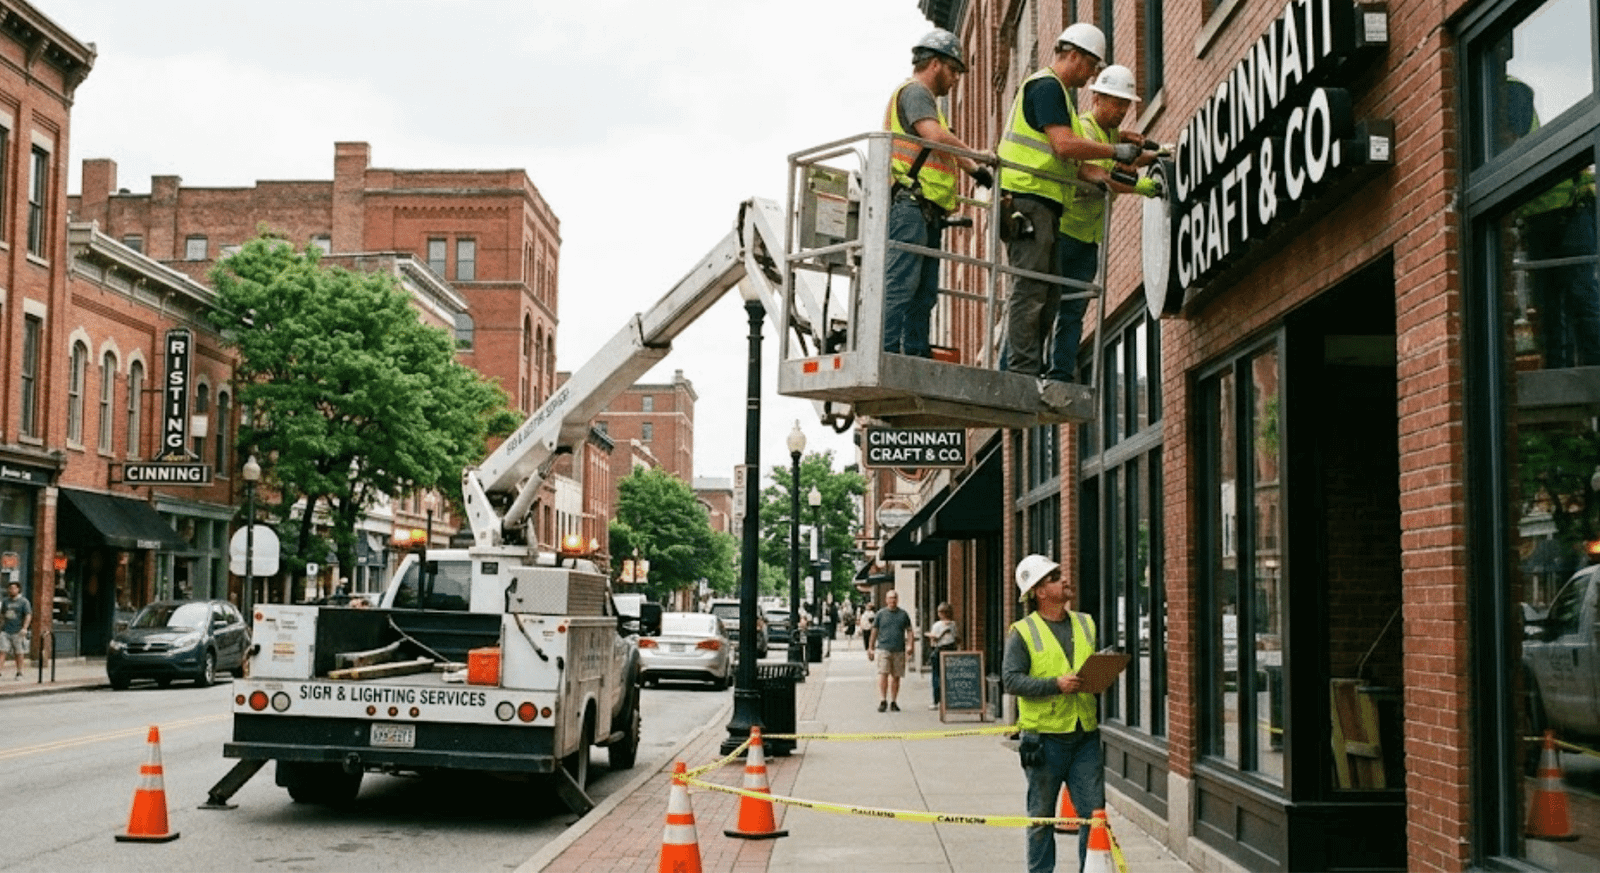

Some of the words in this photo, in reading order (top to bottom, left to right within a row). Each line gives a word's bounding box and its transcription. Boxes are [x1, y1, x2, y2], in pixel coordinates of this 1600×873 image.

[1175, 0, 1331, 202] CINCINNATI
[1177, 153, 1252, 289] CRAFT
[1258, 137, 1277, 225] &
[1284, 87, 1341, 201] CO.
[167, 340, 185, 448] RISTING
[870, 431, 961, 446] CINCINNATI
[870, 447, 922, 461] CRAFT
[925, 447, 936, 461] &
[939, 447, 963, 461] CO.
[337, 685, 346, 701] &
[350, 686, 416, 704] LIGHTING
[419, 689, 487, 707] SERVICES
